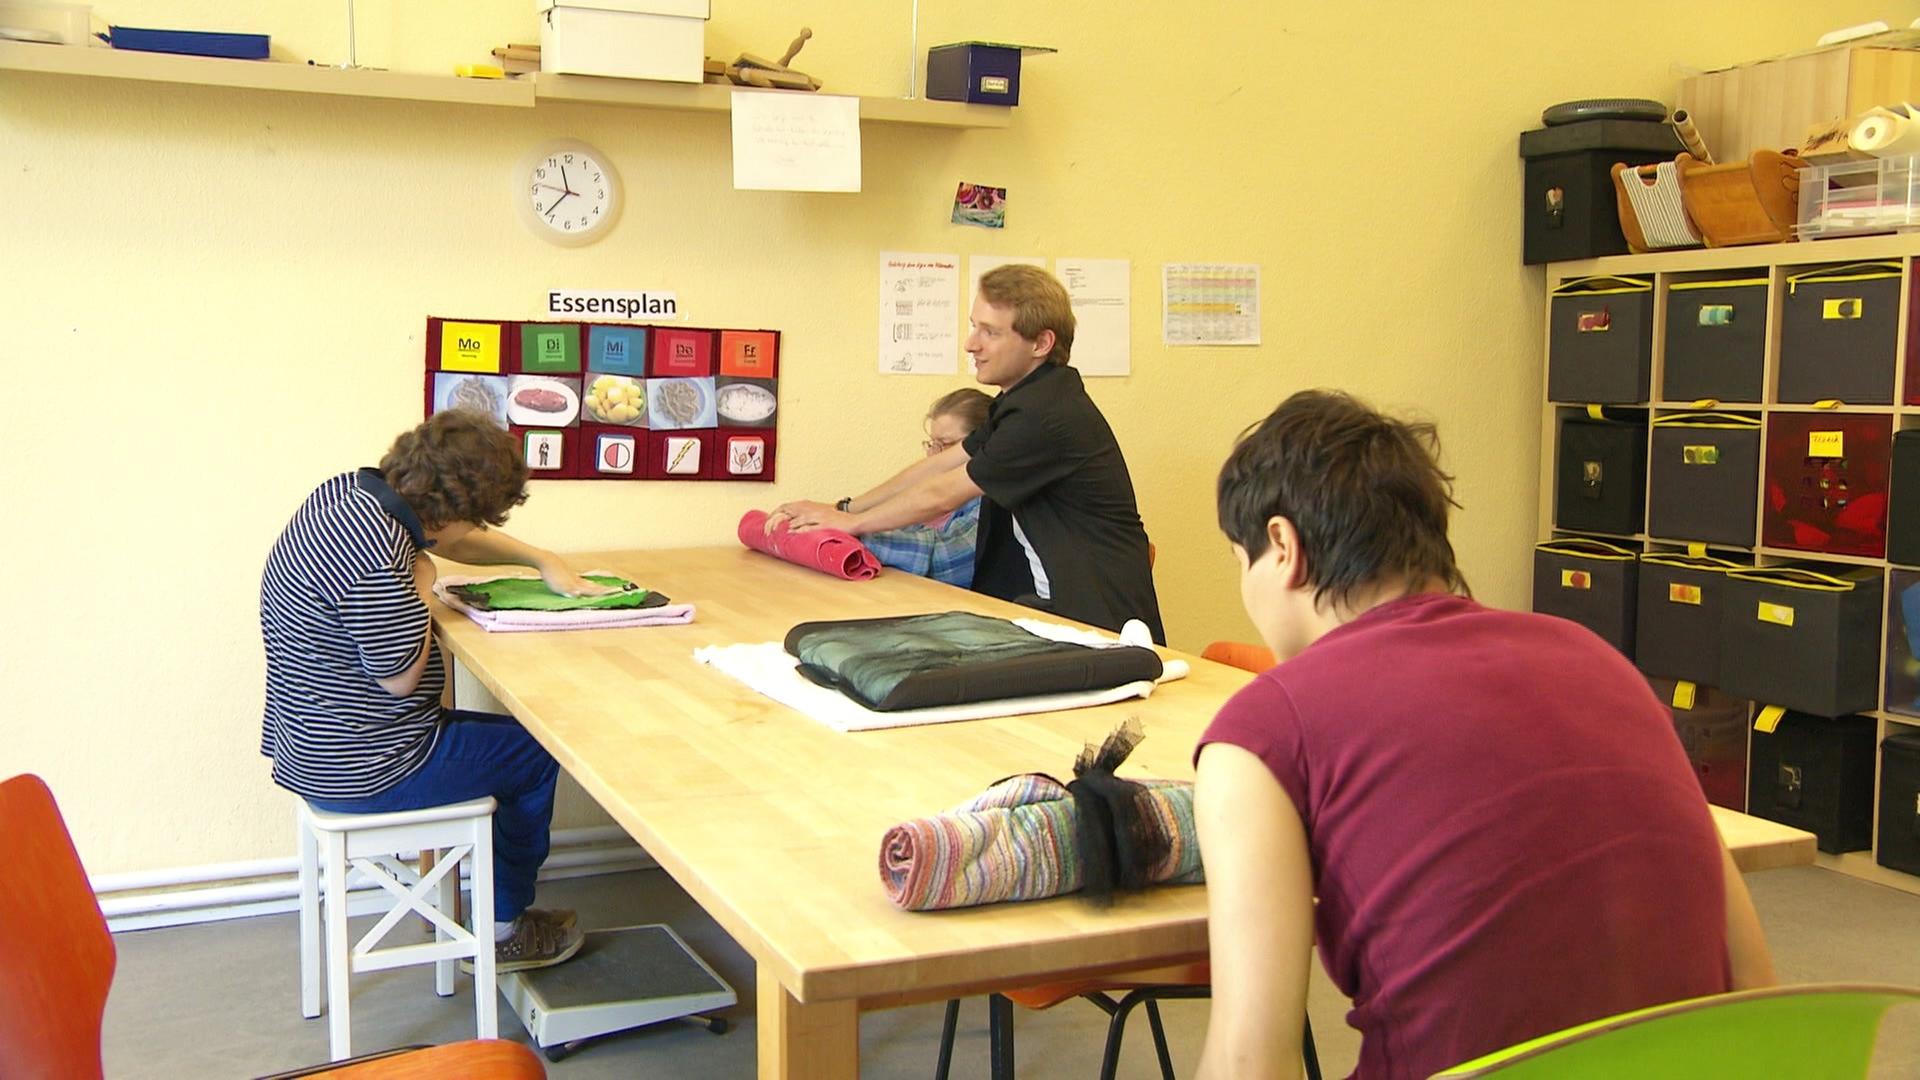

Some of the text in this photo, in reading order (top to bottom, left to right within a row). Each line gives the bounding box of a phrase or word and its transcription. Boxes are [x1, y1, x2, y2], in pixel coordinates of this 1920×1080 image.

[548, 158, 557, 168] 11
[564, 154, 573, 164] 12
[536, 168, 546, 179] 10
[593, 173, 600, 182] 2
[532, 184, 538, 195] 9
[598, 190, 604, 200] 3
[536, 203, 542, 212] 8
[592, 206, 599, 214] 4
[549, 214, 556, 224] 7
[581, 217, 587, 226] 5
[564, 221, 571, 230] 6
[549, 292, 676, 318] Essensplan
[458, 338, 481, 350] Mo
[546, 338, 560, 350] Di
[606, 341, 624, 353] Mi
[675, 344, 693, 355] Do
[744, 344, 756, 355] Fr
